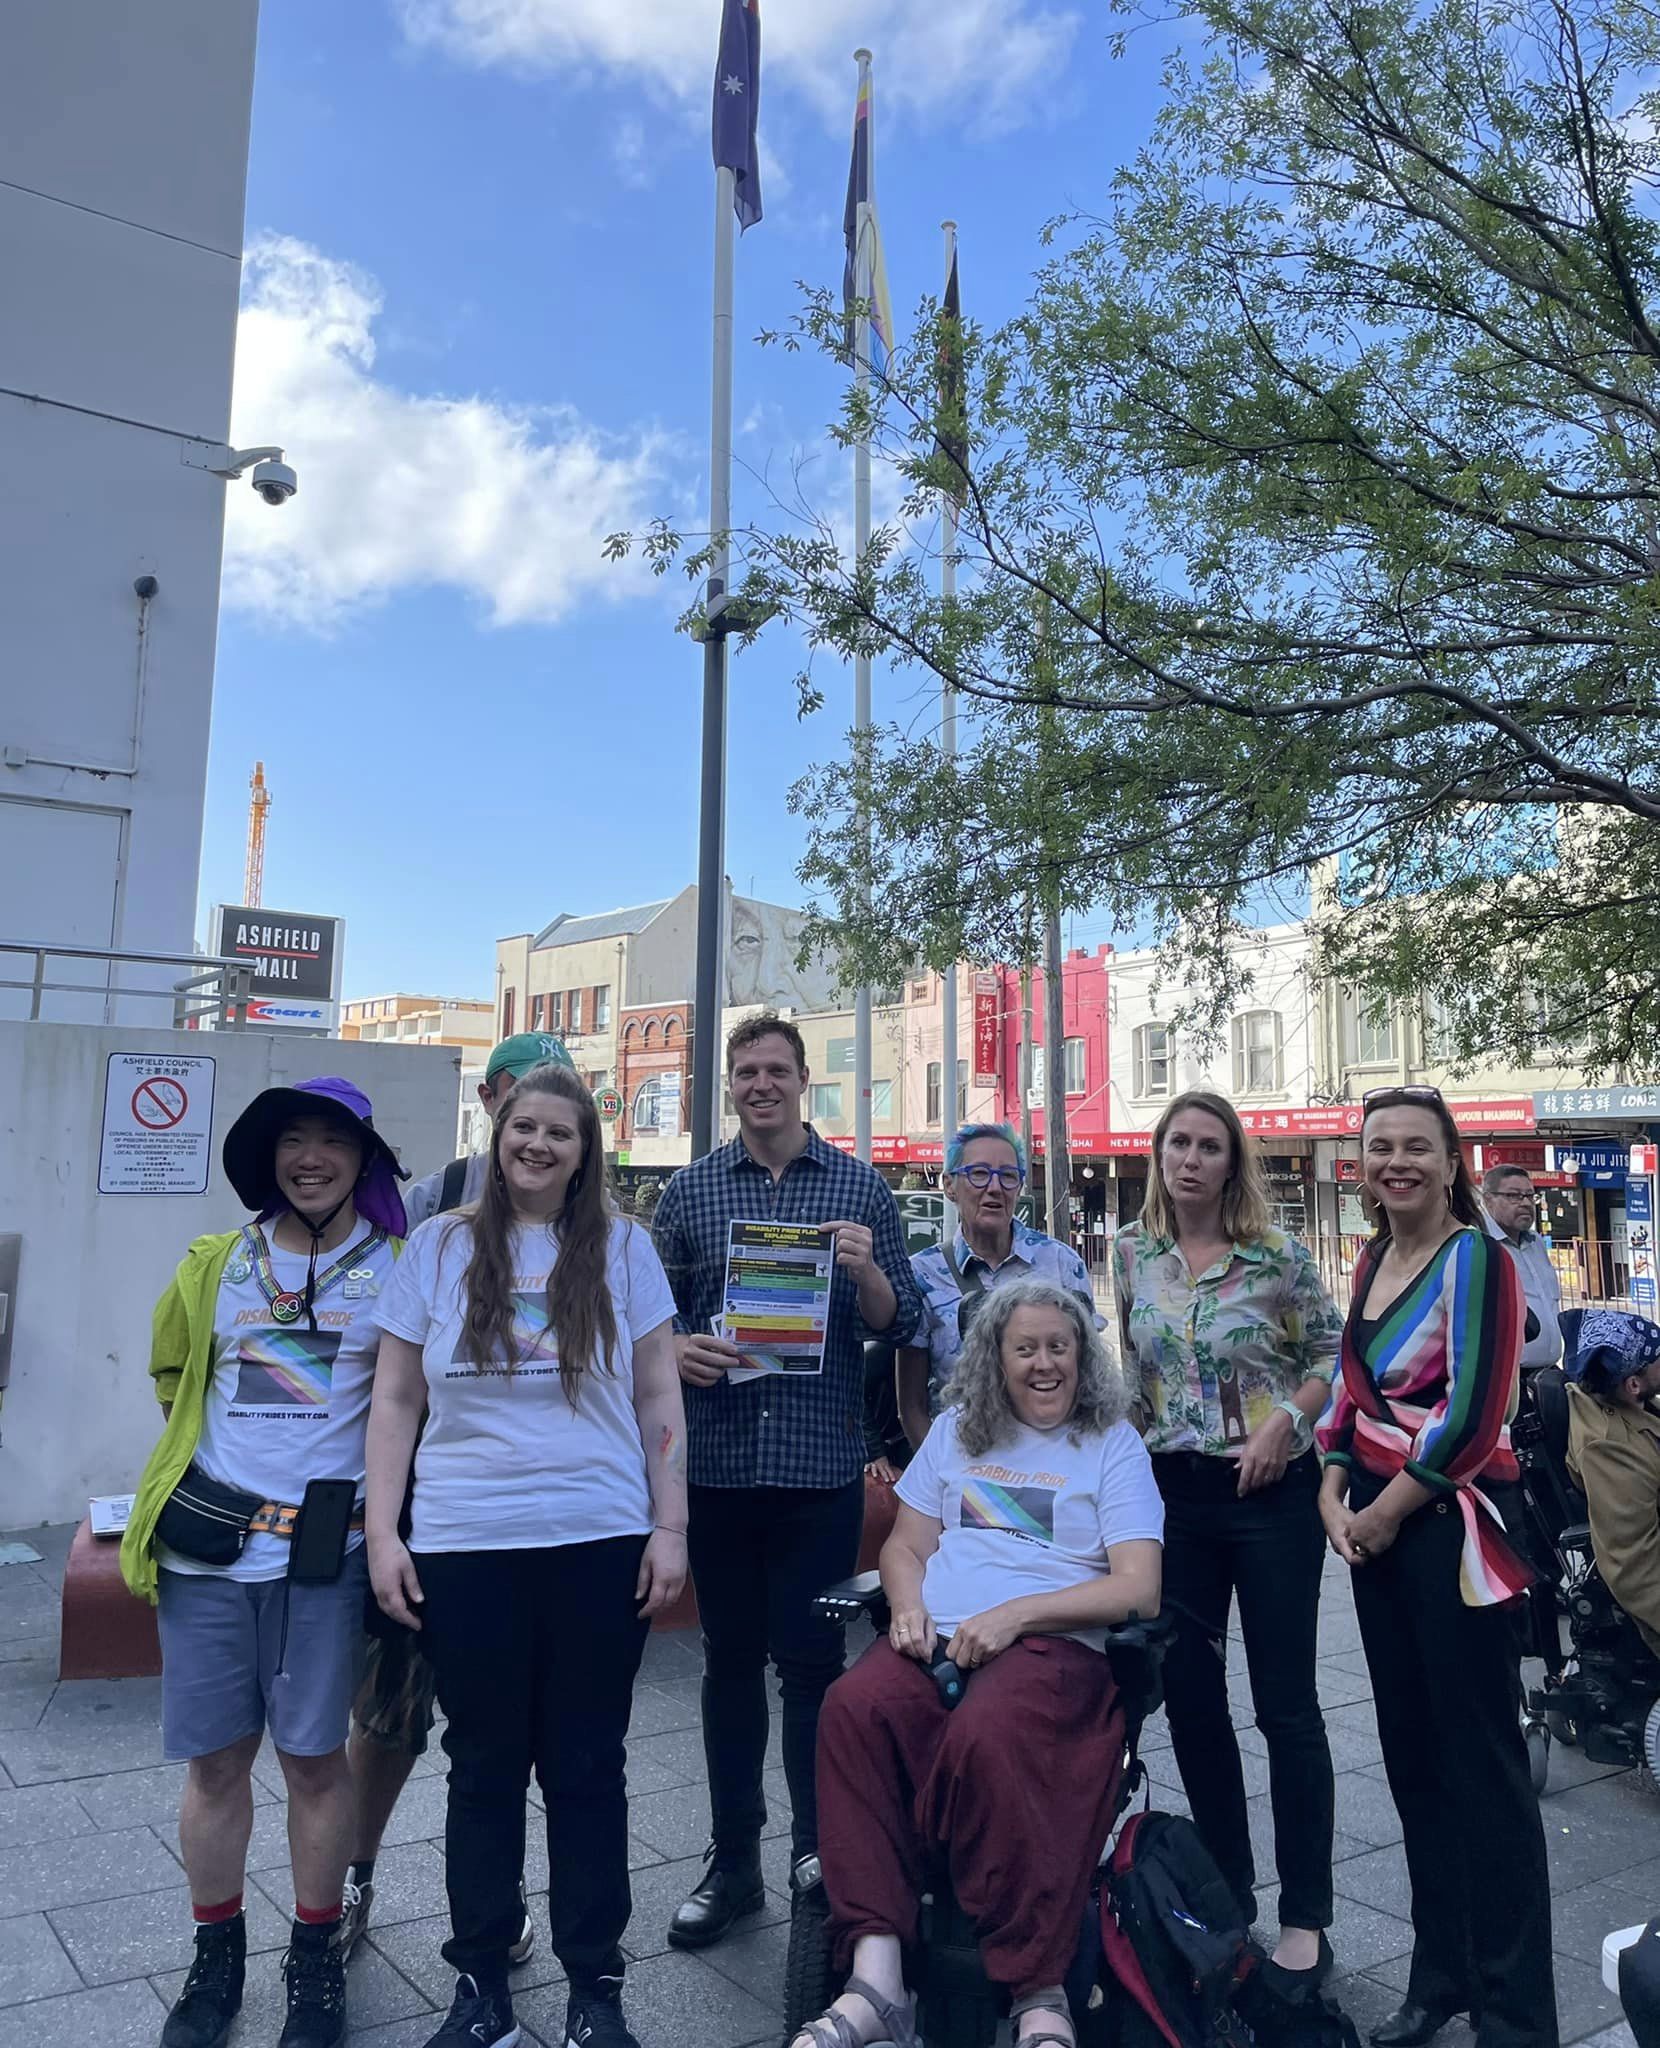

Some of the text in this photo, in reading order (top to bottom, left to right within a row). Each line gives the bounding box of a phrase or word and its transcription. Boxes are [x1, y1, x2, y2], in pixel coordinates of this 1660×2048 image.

[236, 923, 320, 951] ASHFIELD
[254, 956, 298, 980] MALL
[122, 1057, 203, 1068] ASHFIELD COUNCIL
[603, 1101, 617, 1110] VB
[1543, 1093, 1611, 1114] 龍泉海鮮
[1110, 1138, 1130, 1148] NEW
[1590, 1152, 1606, 1168] JIU
[745, 1225, 780, 1234] DISABILITY
[763, 1232, 799, 1241] EXPLAINED
[316, 1310, 356, 1327] PRIDE
